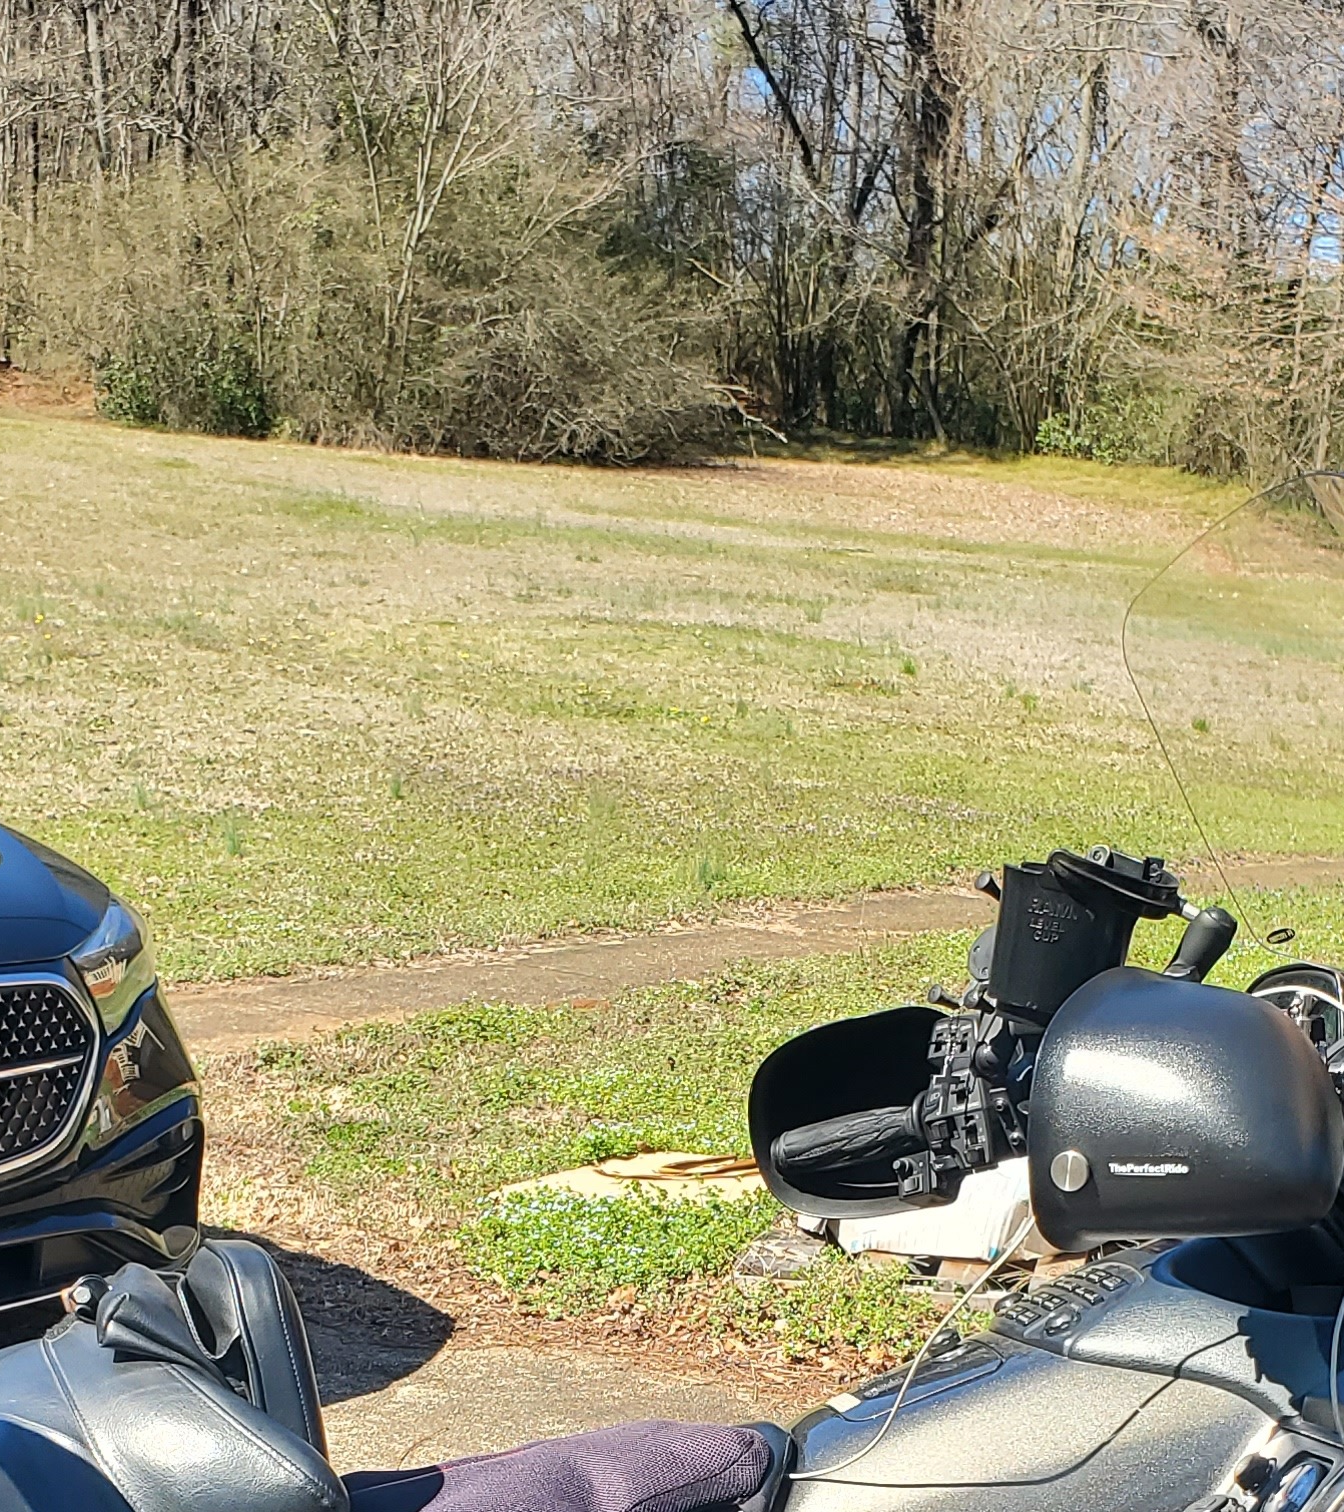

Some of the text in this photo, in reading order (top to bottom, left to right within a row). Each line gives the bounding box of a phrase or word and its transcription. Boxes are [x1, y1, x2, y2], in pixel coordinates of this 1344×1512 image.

[1029, 917, 1065, 933] LEVEL
[1033, 929, 1059, 943] CUP
[1108, 1162, 1190, 1174] ThePerfectRide
